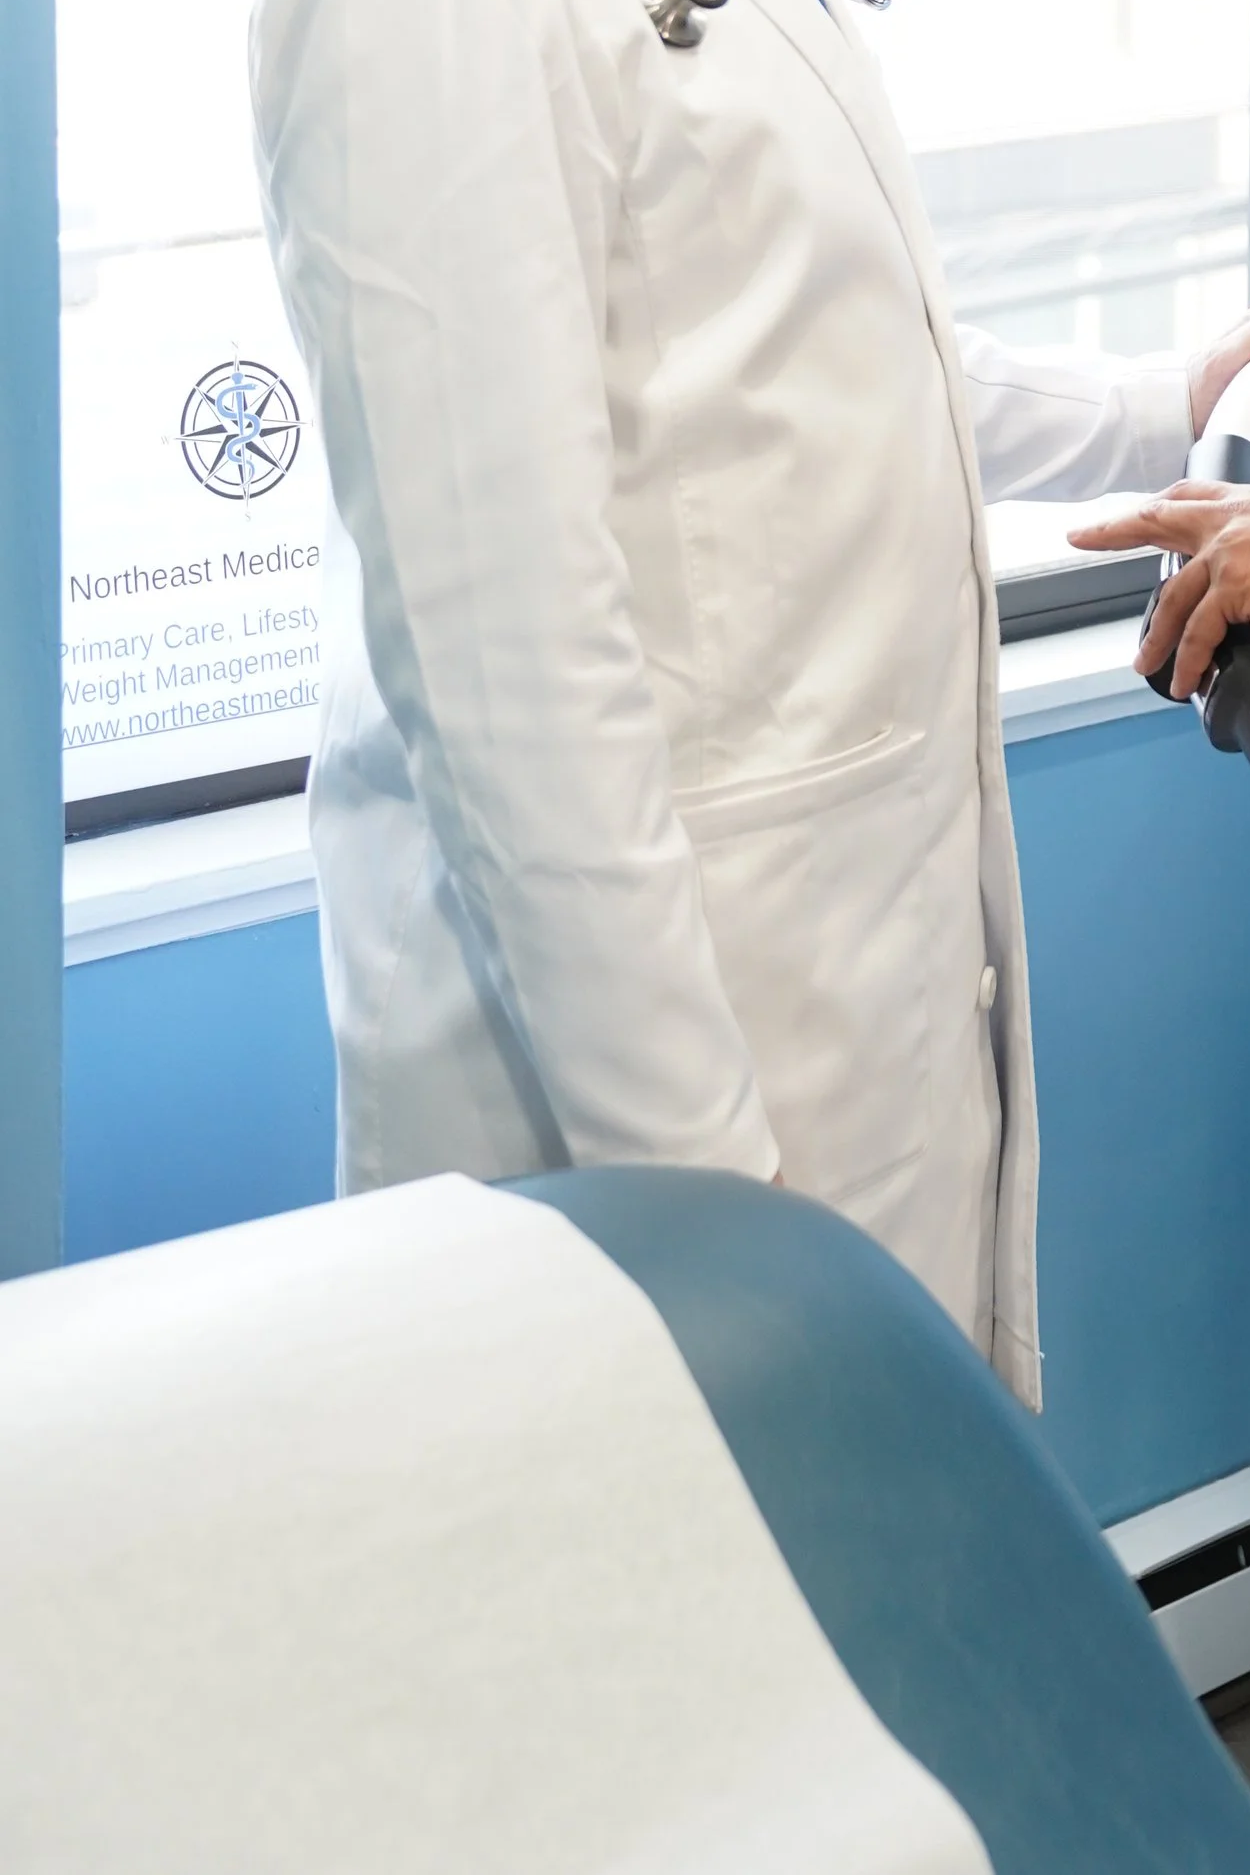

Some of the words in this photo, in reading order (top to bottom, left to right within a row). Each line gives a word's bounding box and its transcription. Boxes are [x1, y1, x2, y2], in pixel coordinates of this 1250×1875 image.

[70, 557, 213, 603] Northeast
[223, 543, 320, 579] Medica
[163, 622, 232, 649] Care,
[156, 641, 320, 691] Management
